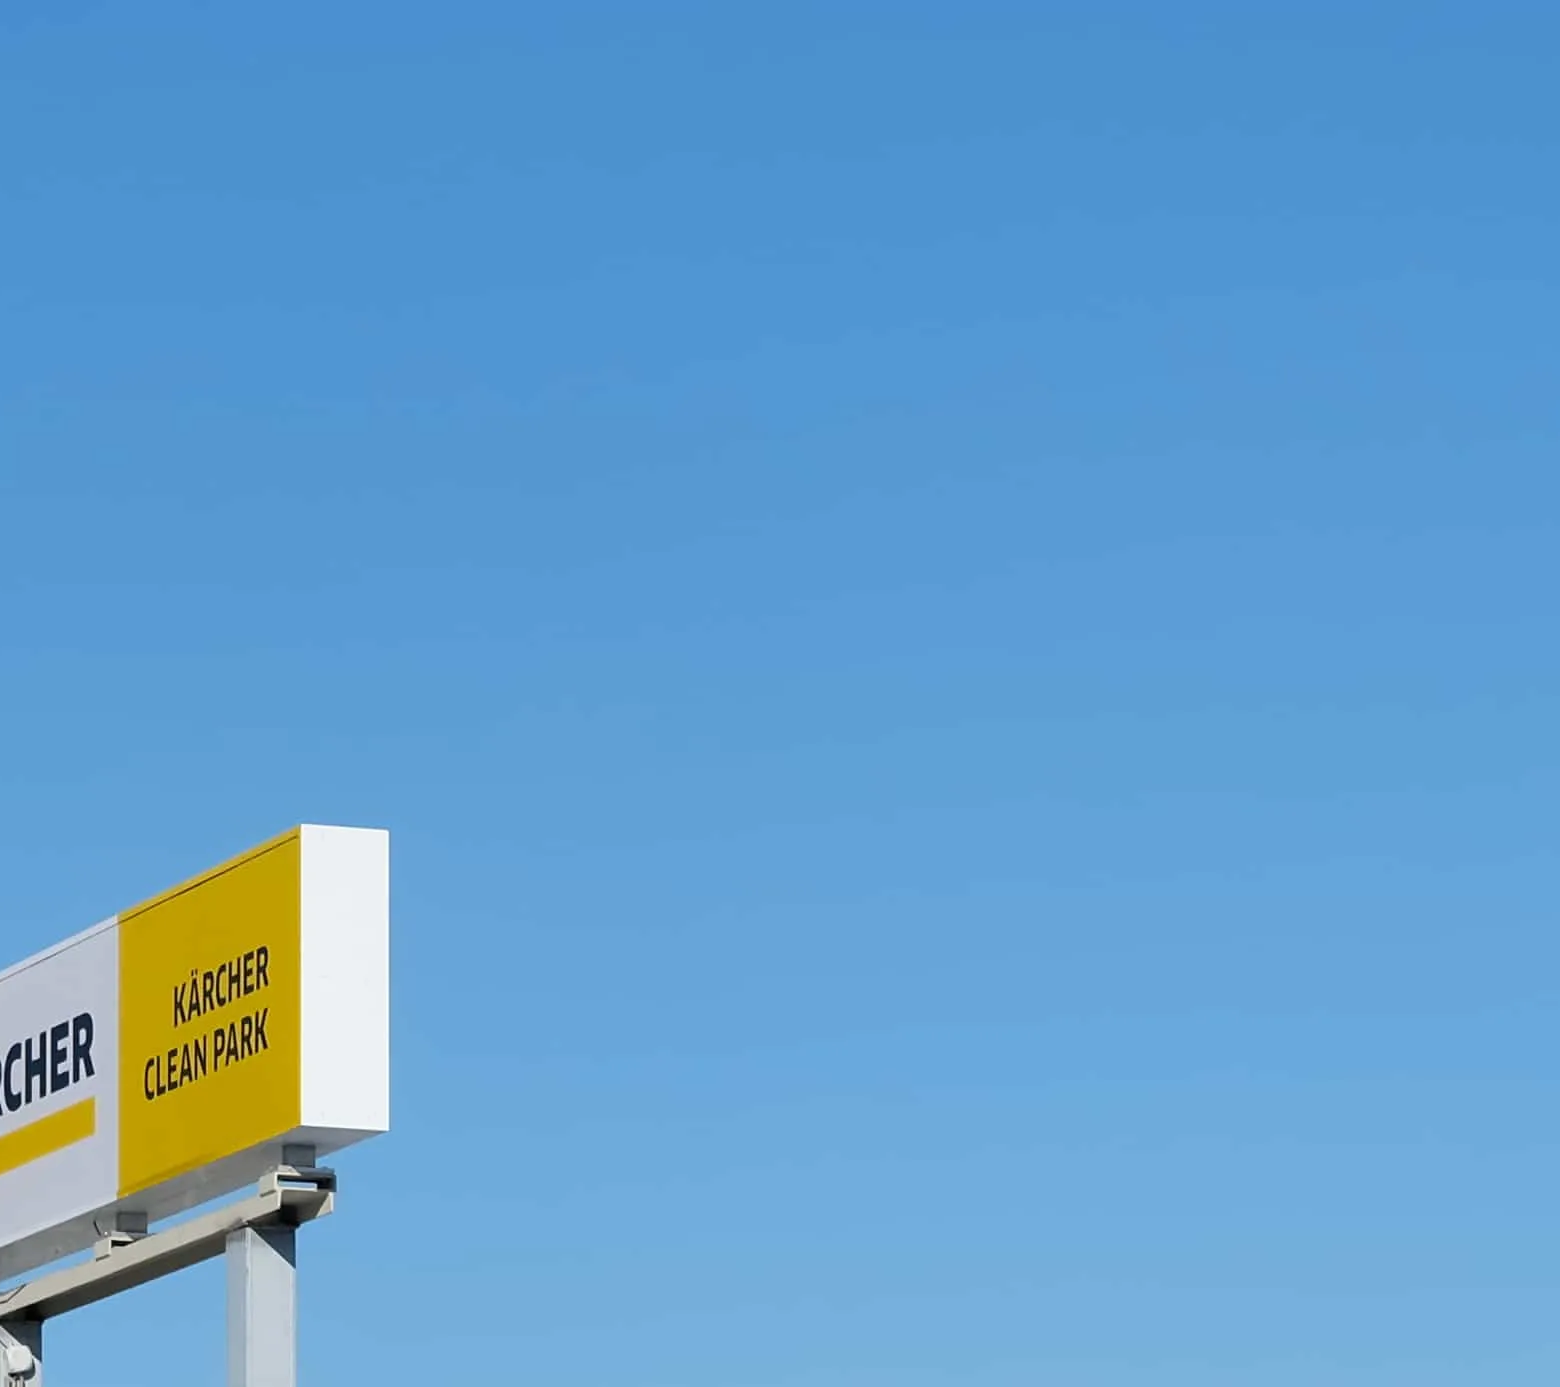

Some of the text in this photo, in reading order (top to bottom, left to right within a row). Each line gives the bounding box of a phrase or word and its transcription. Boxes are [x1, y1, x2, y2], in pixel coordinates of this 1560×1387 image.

[174, 946, 269, 1028] KÄRCHER
[144, 1007, 269, 1101] CLEAN PARK
